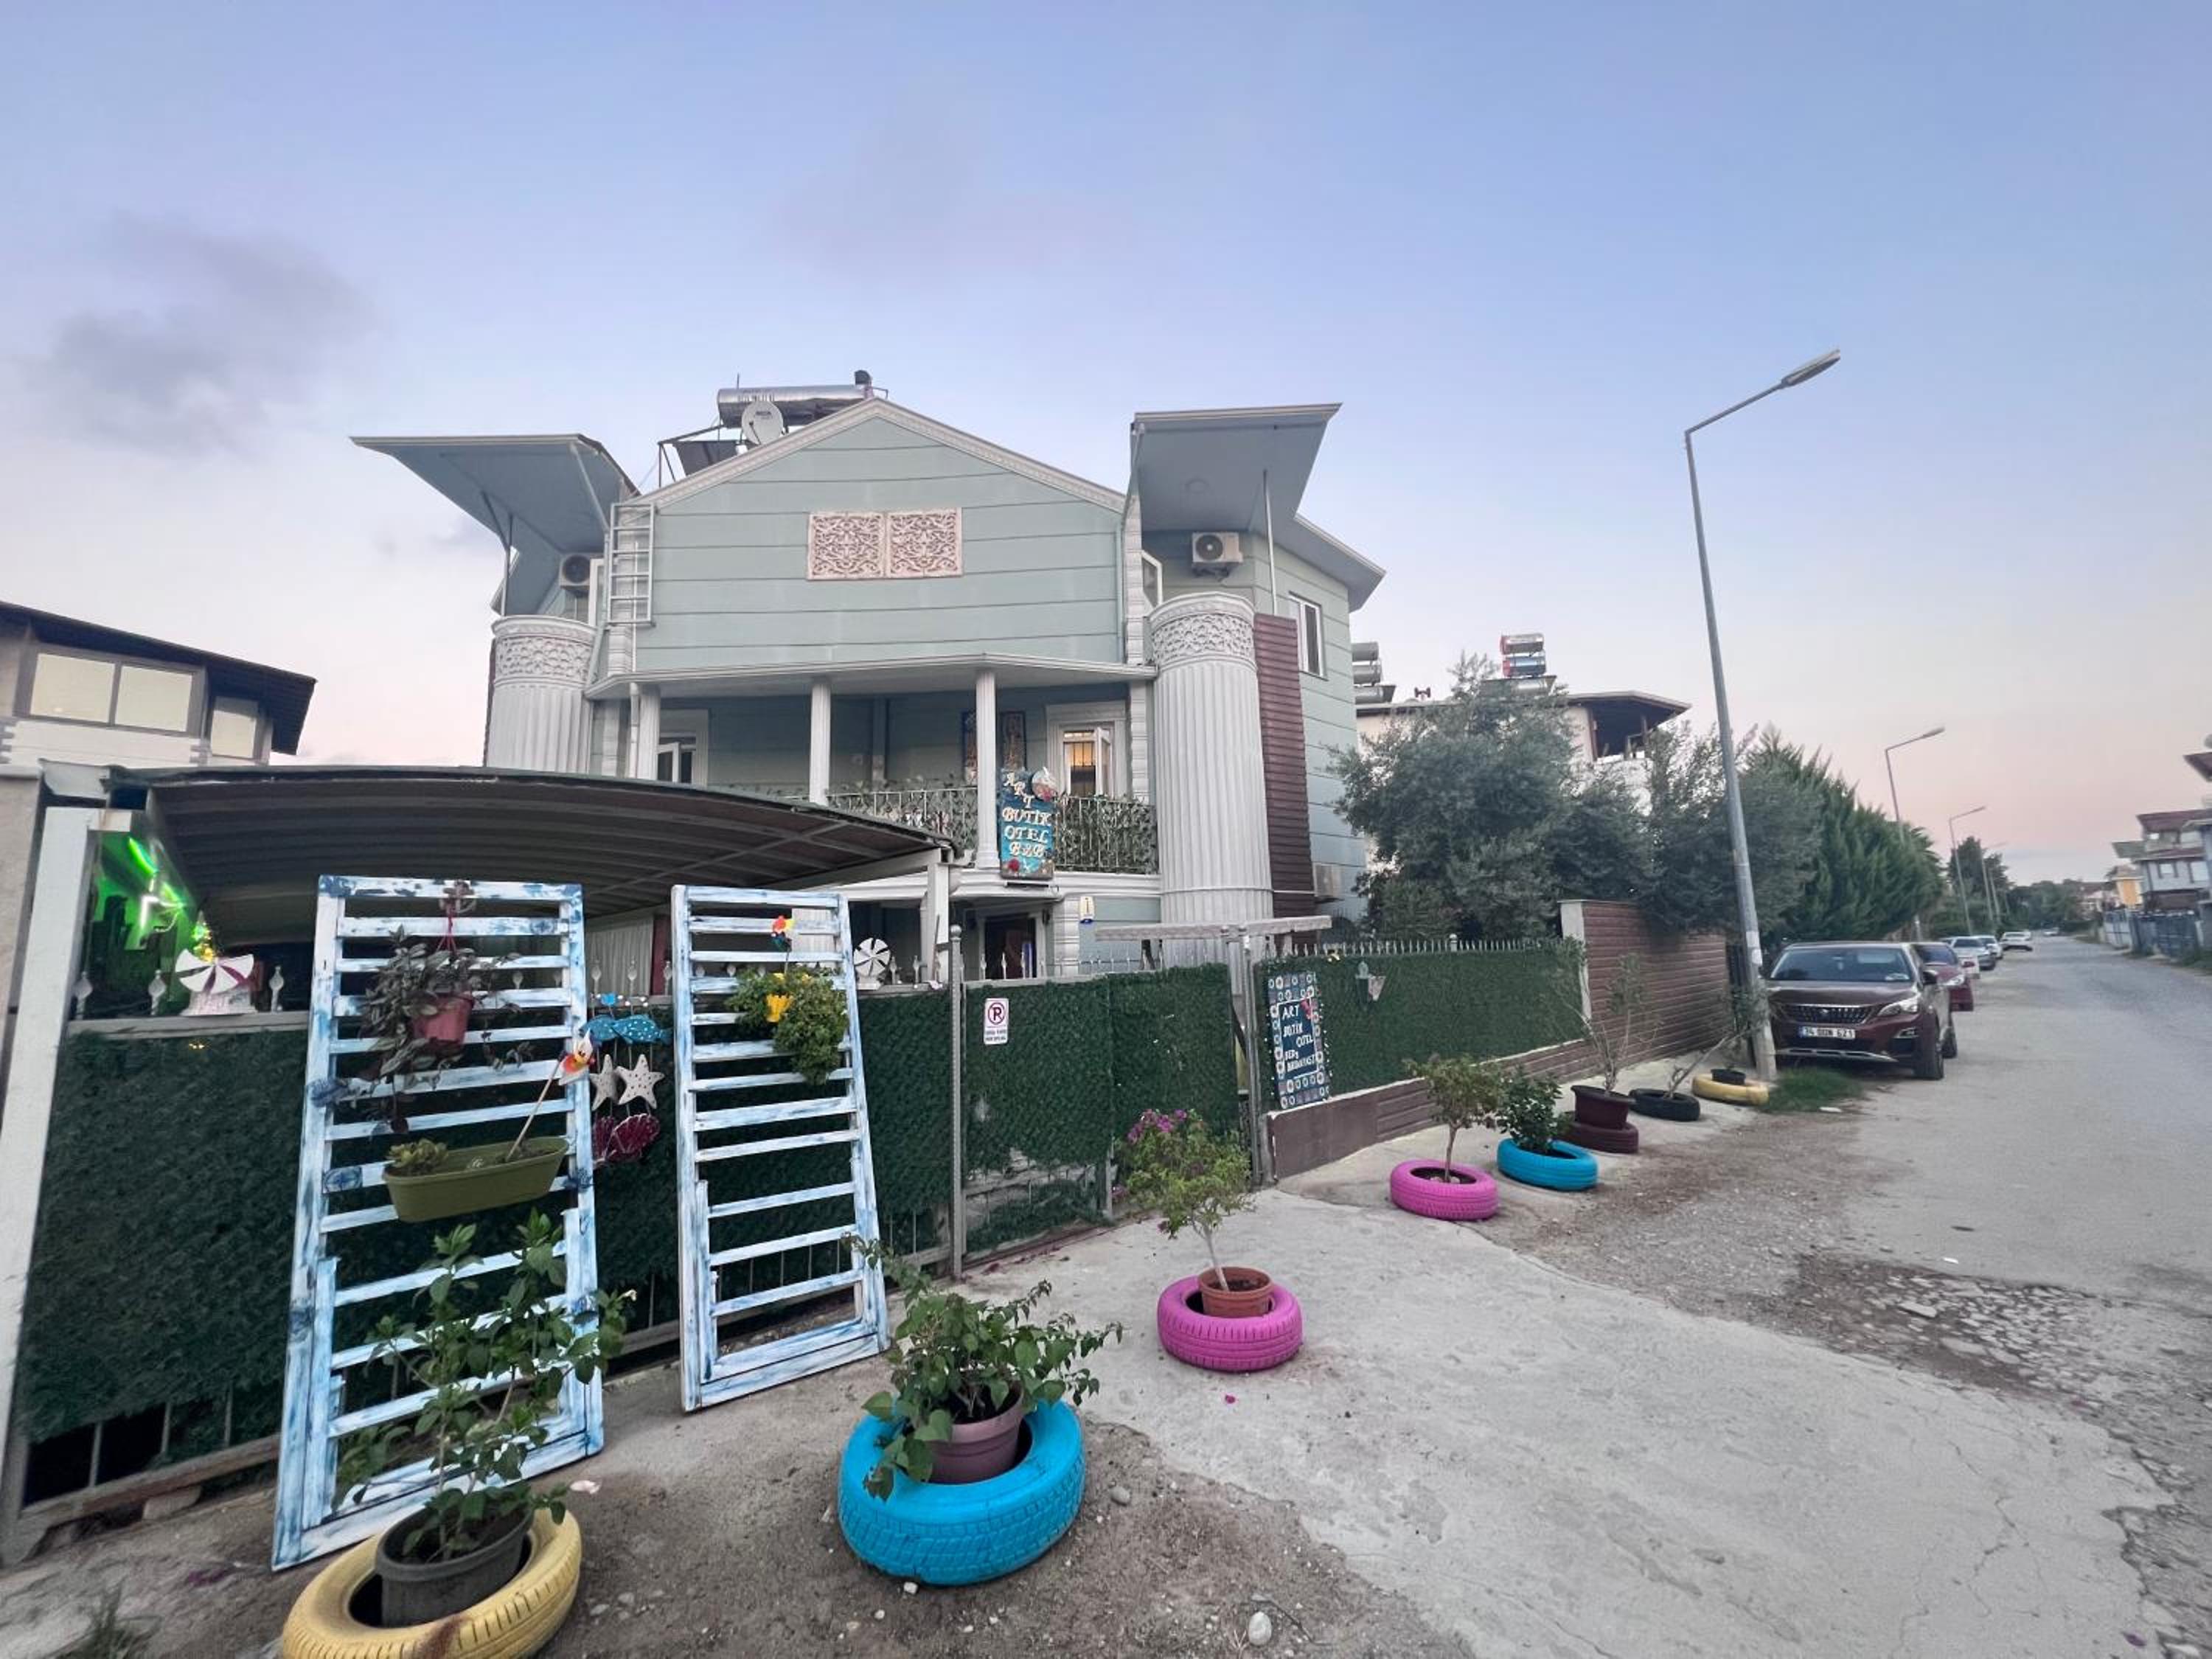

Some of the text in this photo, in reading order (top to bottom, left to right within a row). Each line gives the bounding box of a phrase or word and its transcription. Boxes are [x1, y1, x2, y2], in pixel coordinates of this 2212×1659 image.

[1004, 772, 1034, 809] ART
[1004, 825, 1049, 844] OTEL
[1283, 1006, 1299, 1020] ART
